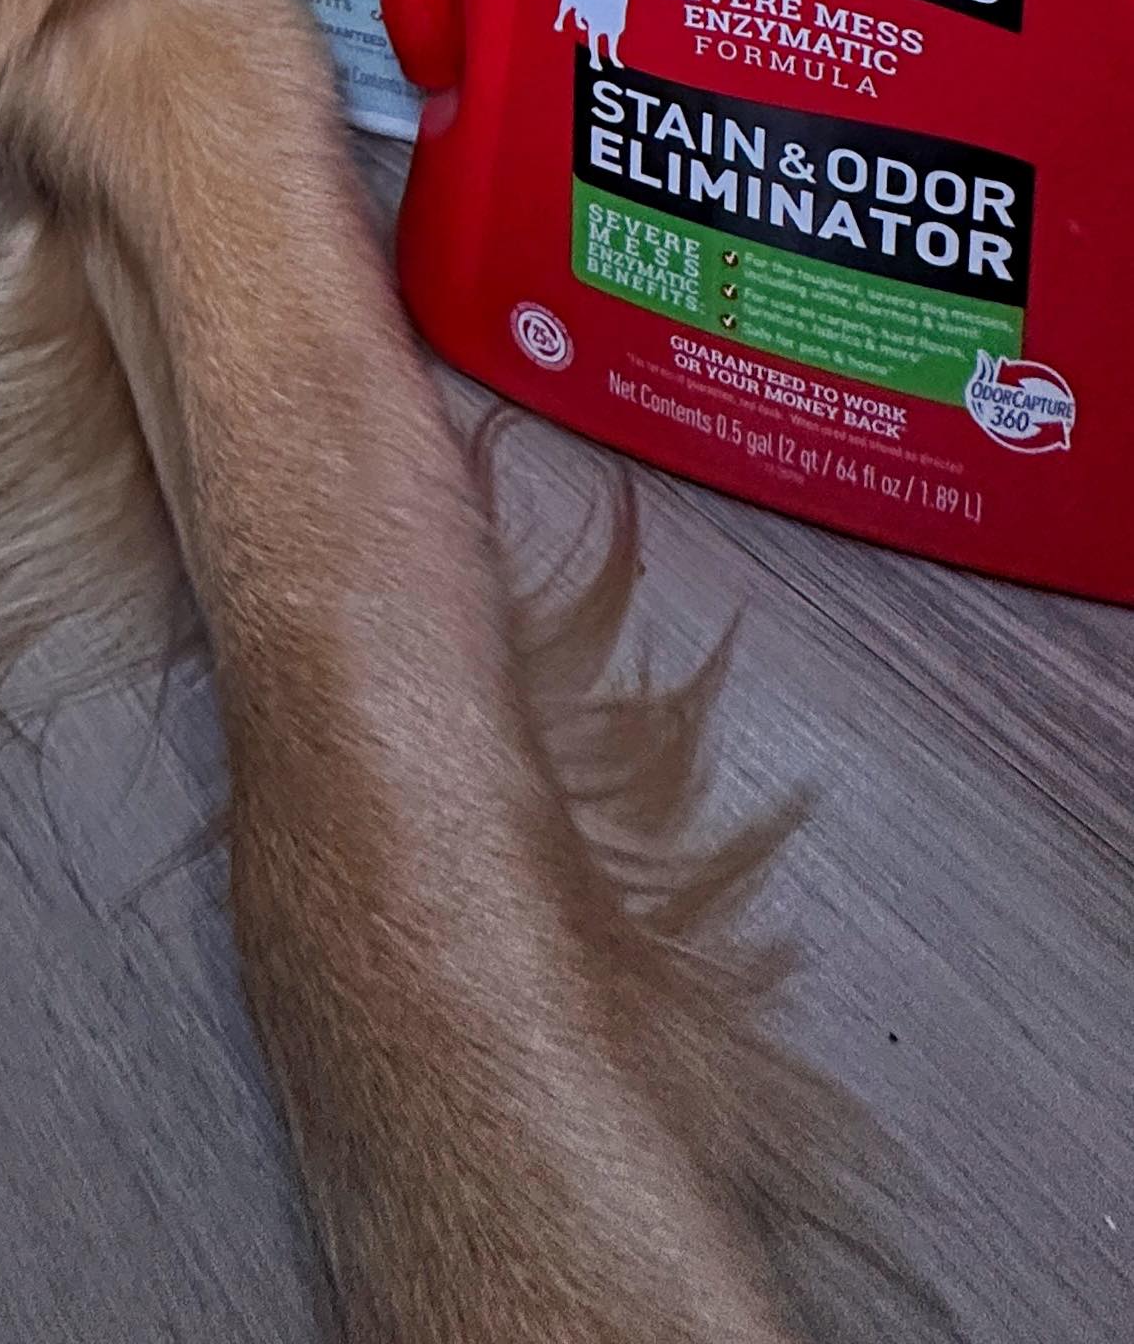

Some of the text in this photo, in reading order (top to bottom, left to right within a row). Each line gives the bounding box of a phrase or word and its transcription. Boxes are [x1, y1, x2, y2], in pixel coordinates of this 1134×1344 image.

[684, 7, 898, 77] ENZYMATIC
[814, 3, 925, 56] MESS
[694, 35, 879, 98] FORMULA
[590, 81, 1016, 229] STAIN & ODOR
[588, 202, 701, 260] SEVERE
[590, 127, 1014, 283] ELIMINATOR
[587, 241, 701, 296] ENZYMATIC
[669, 335, 806, 393] GUARANTEED
[809, 381, 839, 404] TO
[843, 393, 907, 425] WORK
[674, 354, 702, 376] OR
[705, 363, 759, 396] YOUR
[764, 385, 839, 422] MONEY
[971, 381, 1075, 419] ODORCAPTURE
[608, 369, 637, 404] Net
[639, 383, 713, 434] Contents
[716, 413, 742, 446] 0.5
[747, 427, 774, 459] gal
[800, 445, 819, 476] qt
[836, 455, 858, 483] 64
[863, 463, 876, 489] fl
[881, 474, 902, 497] oz
[920, 479, 960, 513] 1.89
[990, 405, 1030, 432] 360
